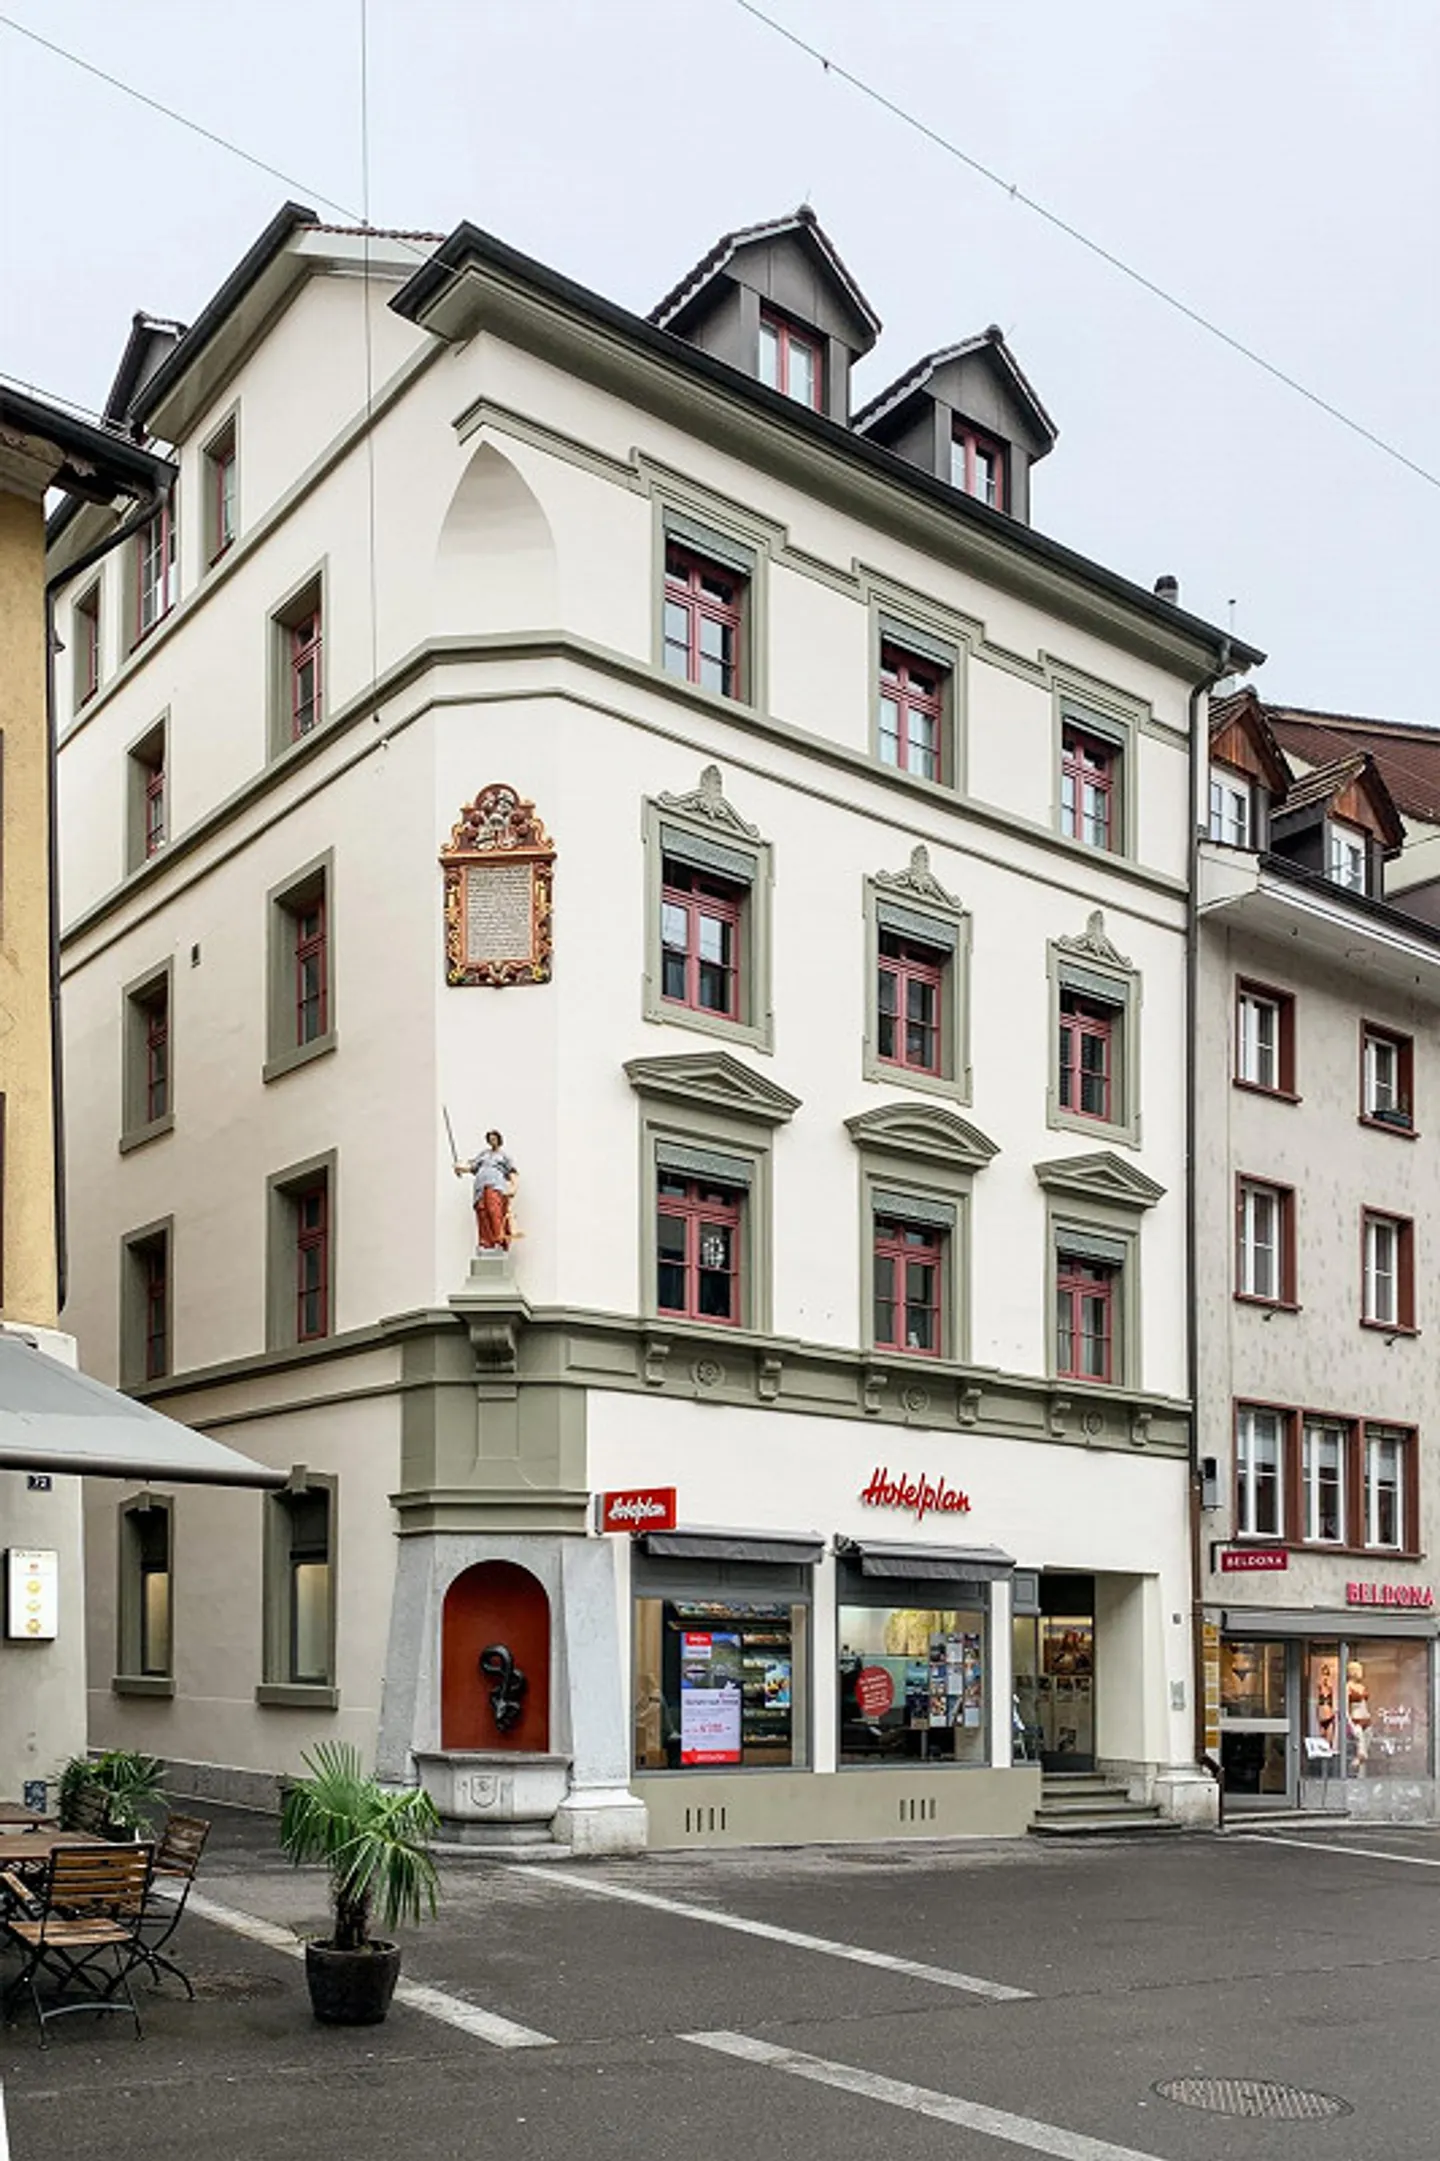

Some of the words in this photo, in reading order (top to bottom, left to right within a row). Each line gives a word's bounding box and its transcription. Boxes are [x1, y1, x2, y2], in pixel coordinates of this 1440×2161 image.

[862, 1467, 971, 1521] Hotelplan
[608, 1496, 666, 1525] Hotelplan
[1226, 1553, 1284, 1567] BELDONA
[1346, 1582, 1434, 1606] BELDONA
